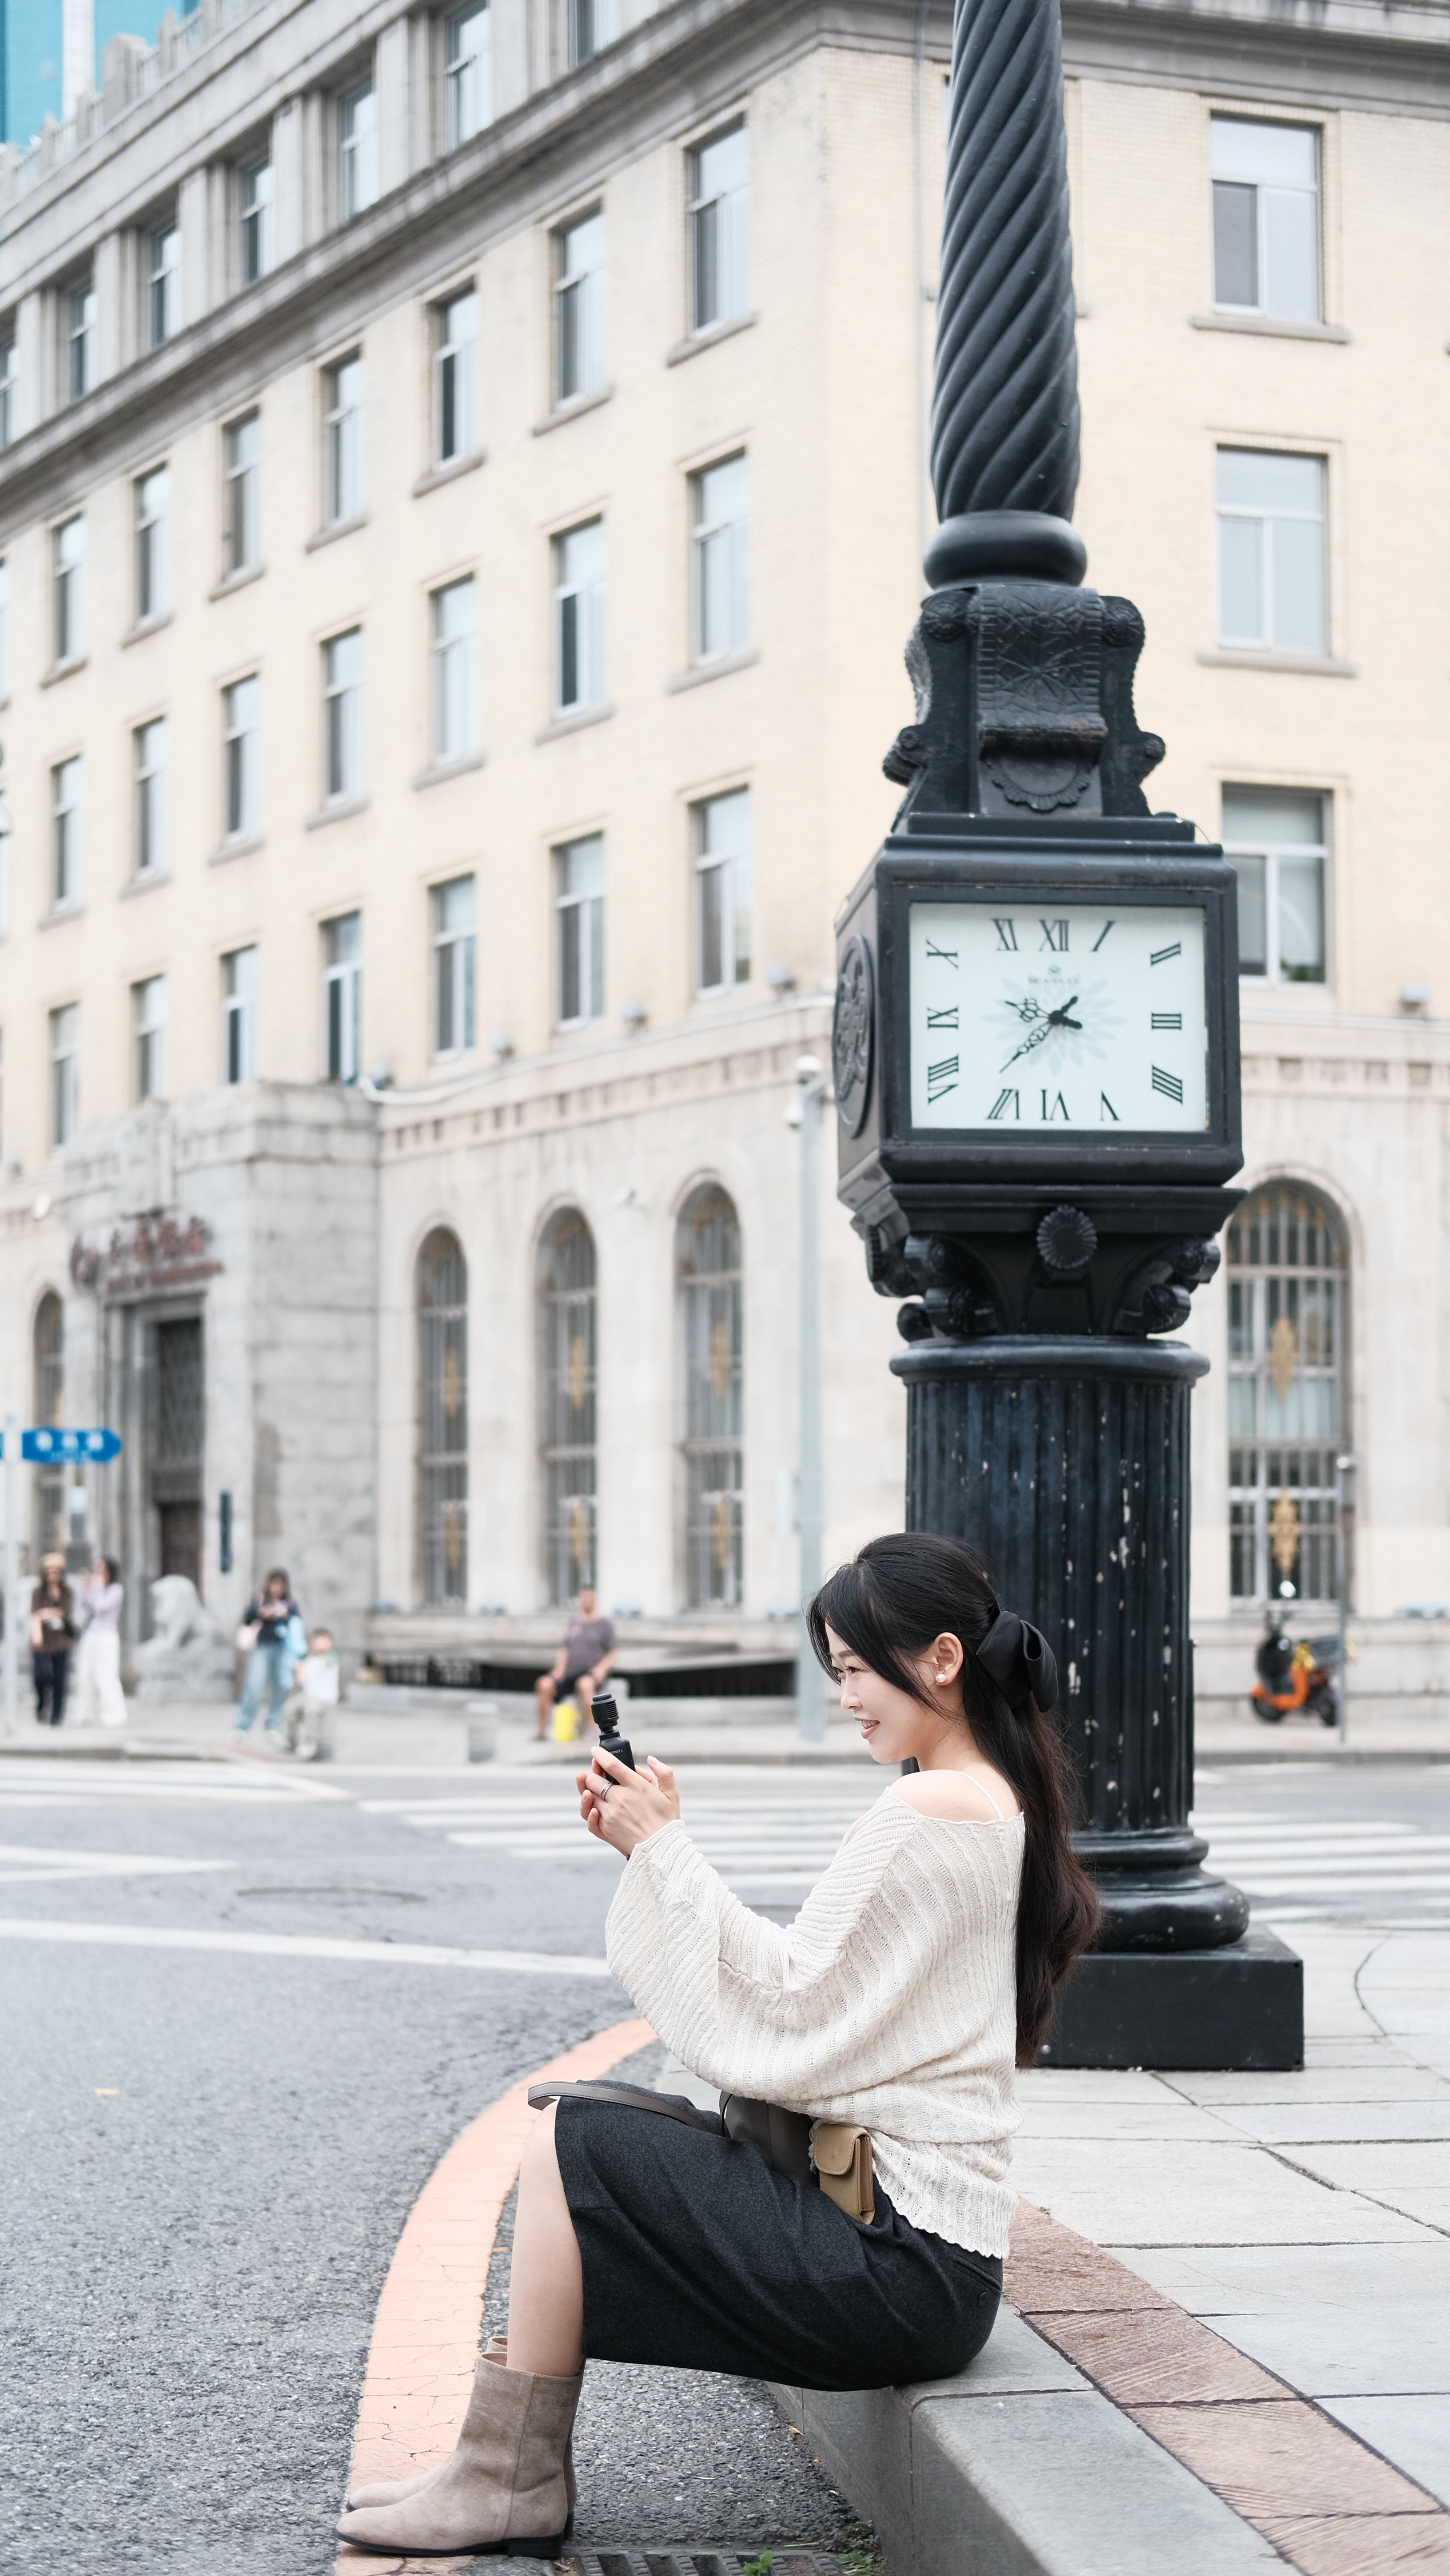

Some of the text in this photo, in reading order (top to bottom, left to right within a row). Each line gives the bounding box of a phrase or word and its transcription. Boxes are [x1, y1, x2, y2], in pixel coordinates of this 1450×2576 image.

[989, 918, 1019, 951] XI
[1039, 919, 1070, 952] XII
[1090, 920, 1116, 952] I
[926, 939, 958, 969] X
[1150, 941, 1181, 966] II
[1151, 1012, 1182, 1030] III
[928, 1053, 959, 1105] VIII
[983, 1088, 1021, 1121] VII
[1040, 1088, 1072, 1121] VI
[1098, 1090, 1121, 1123] V
